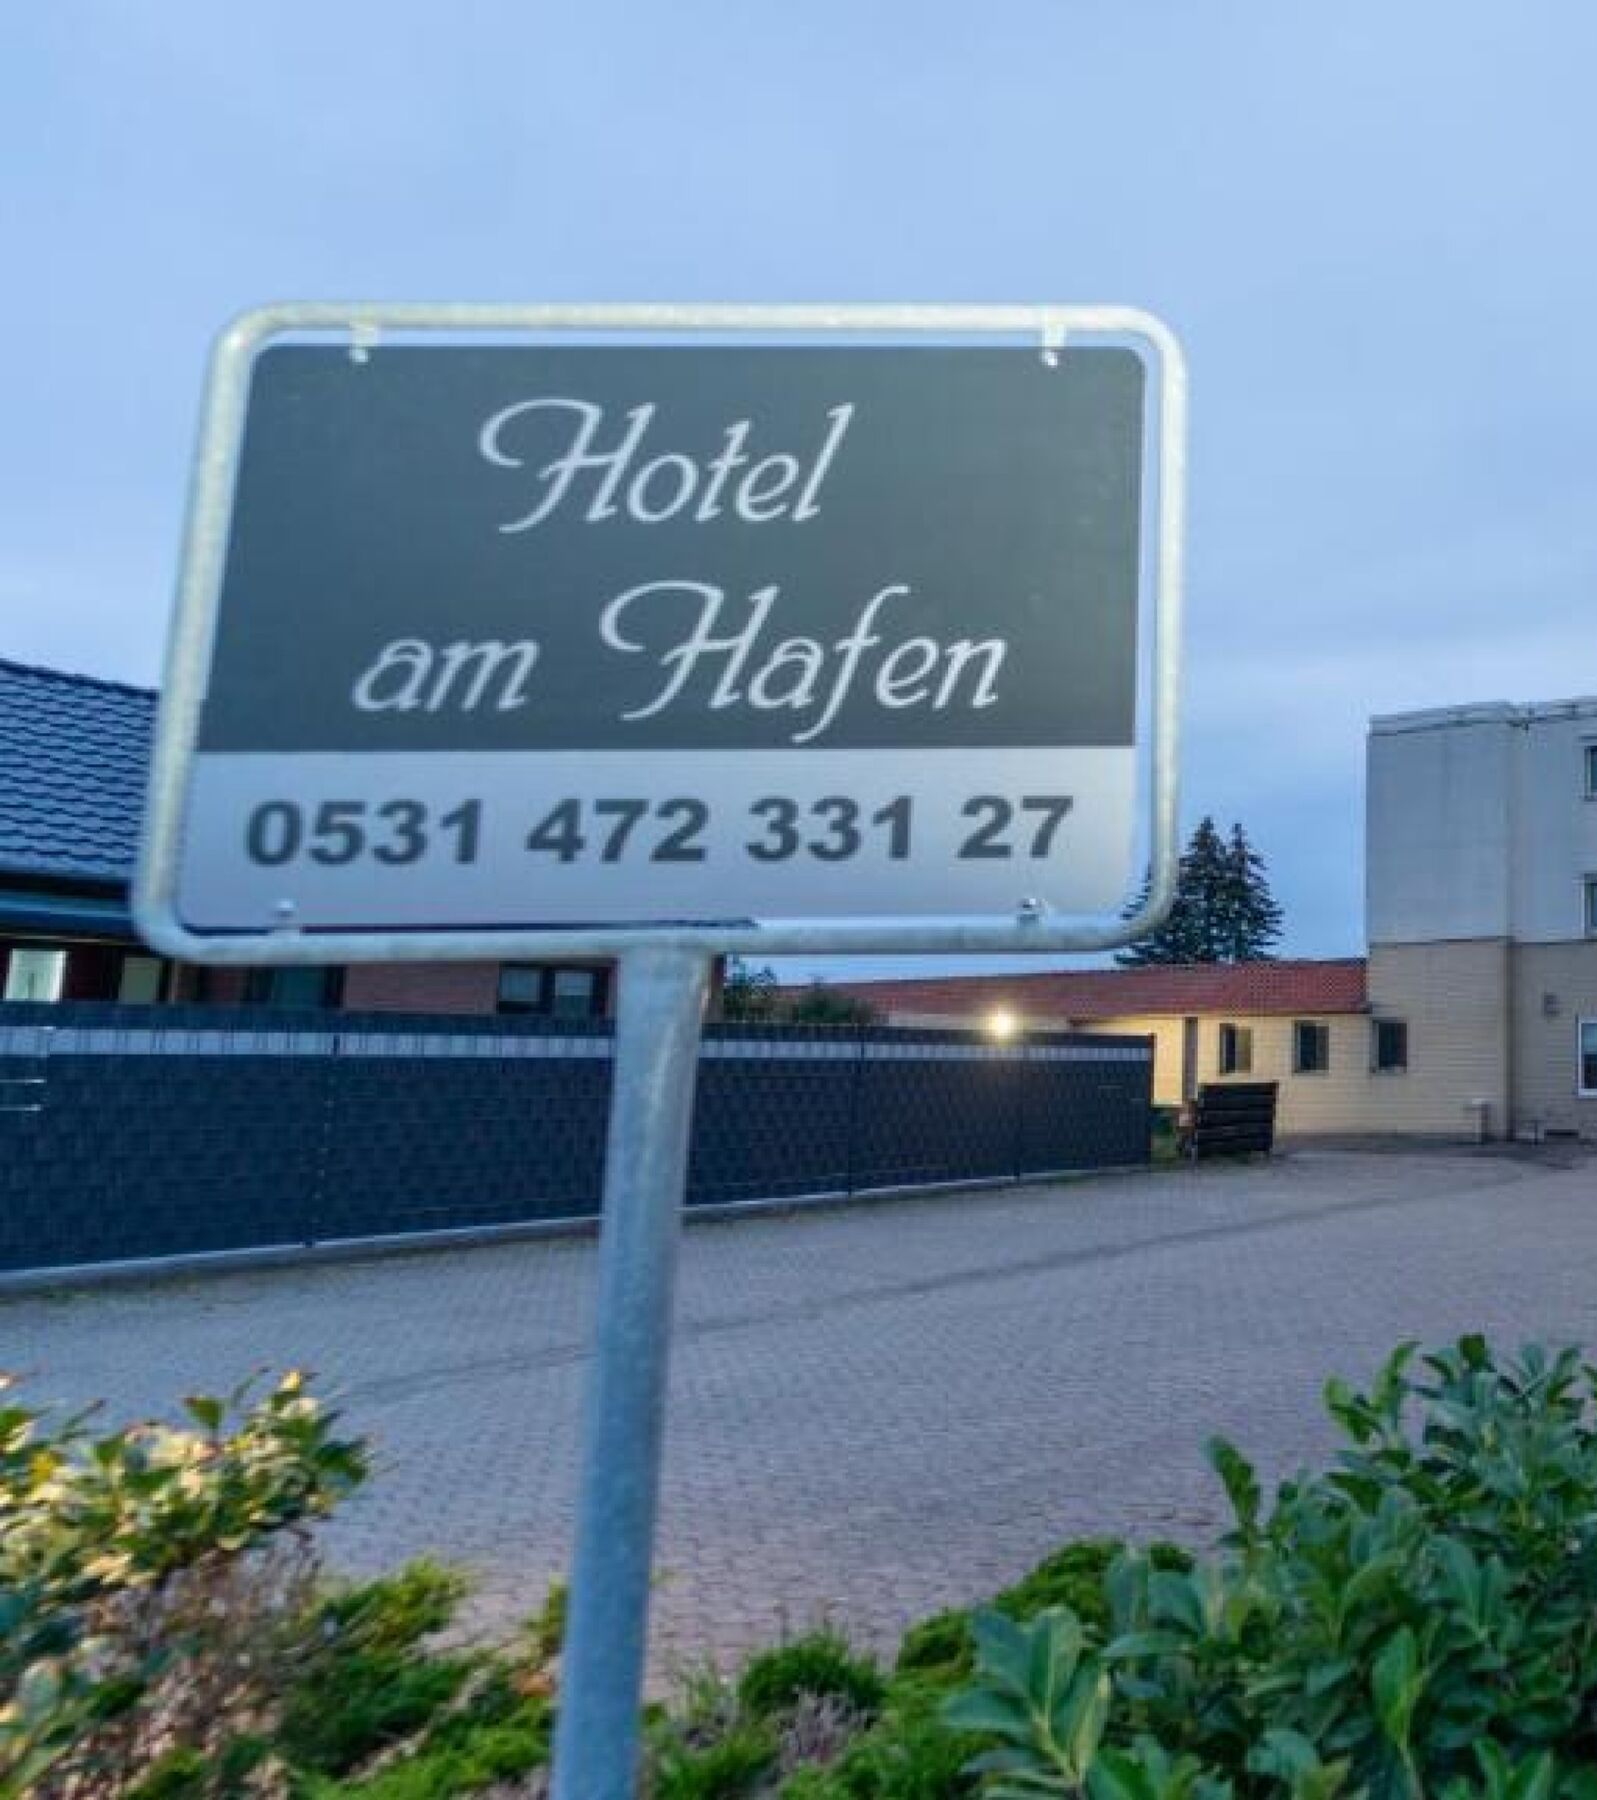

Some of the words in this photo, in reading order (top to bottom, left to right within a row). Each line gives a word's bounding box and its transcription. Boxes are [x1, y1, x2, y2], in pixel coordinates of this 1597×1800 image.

[478, 397, 855, 534] Hotel
[352, 637, 540, 714] am
[598, 580, 1006, 744] Hafen
[246, 799, 480, 868] 0531
[527, 798, 708, 864] 472
[746, 796, 914, 860] 331
[958, 794, 1075, 861] 27
